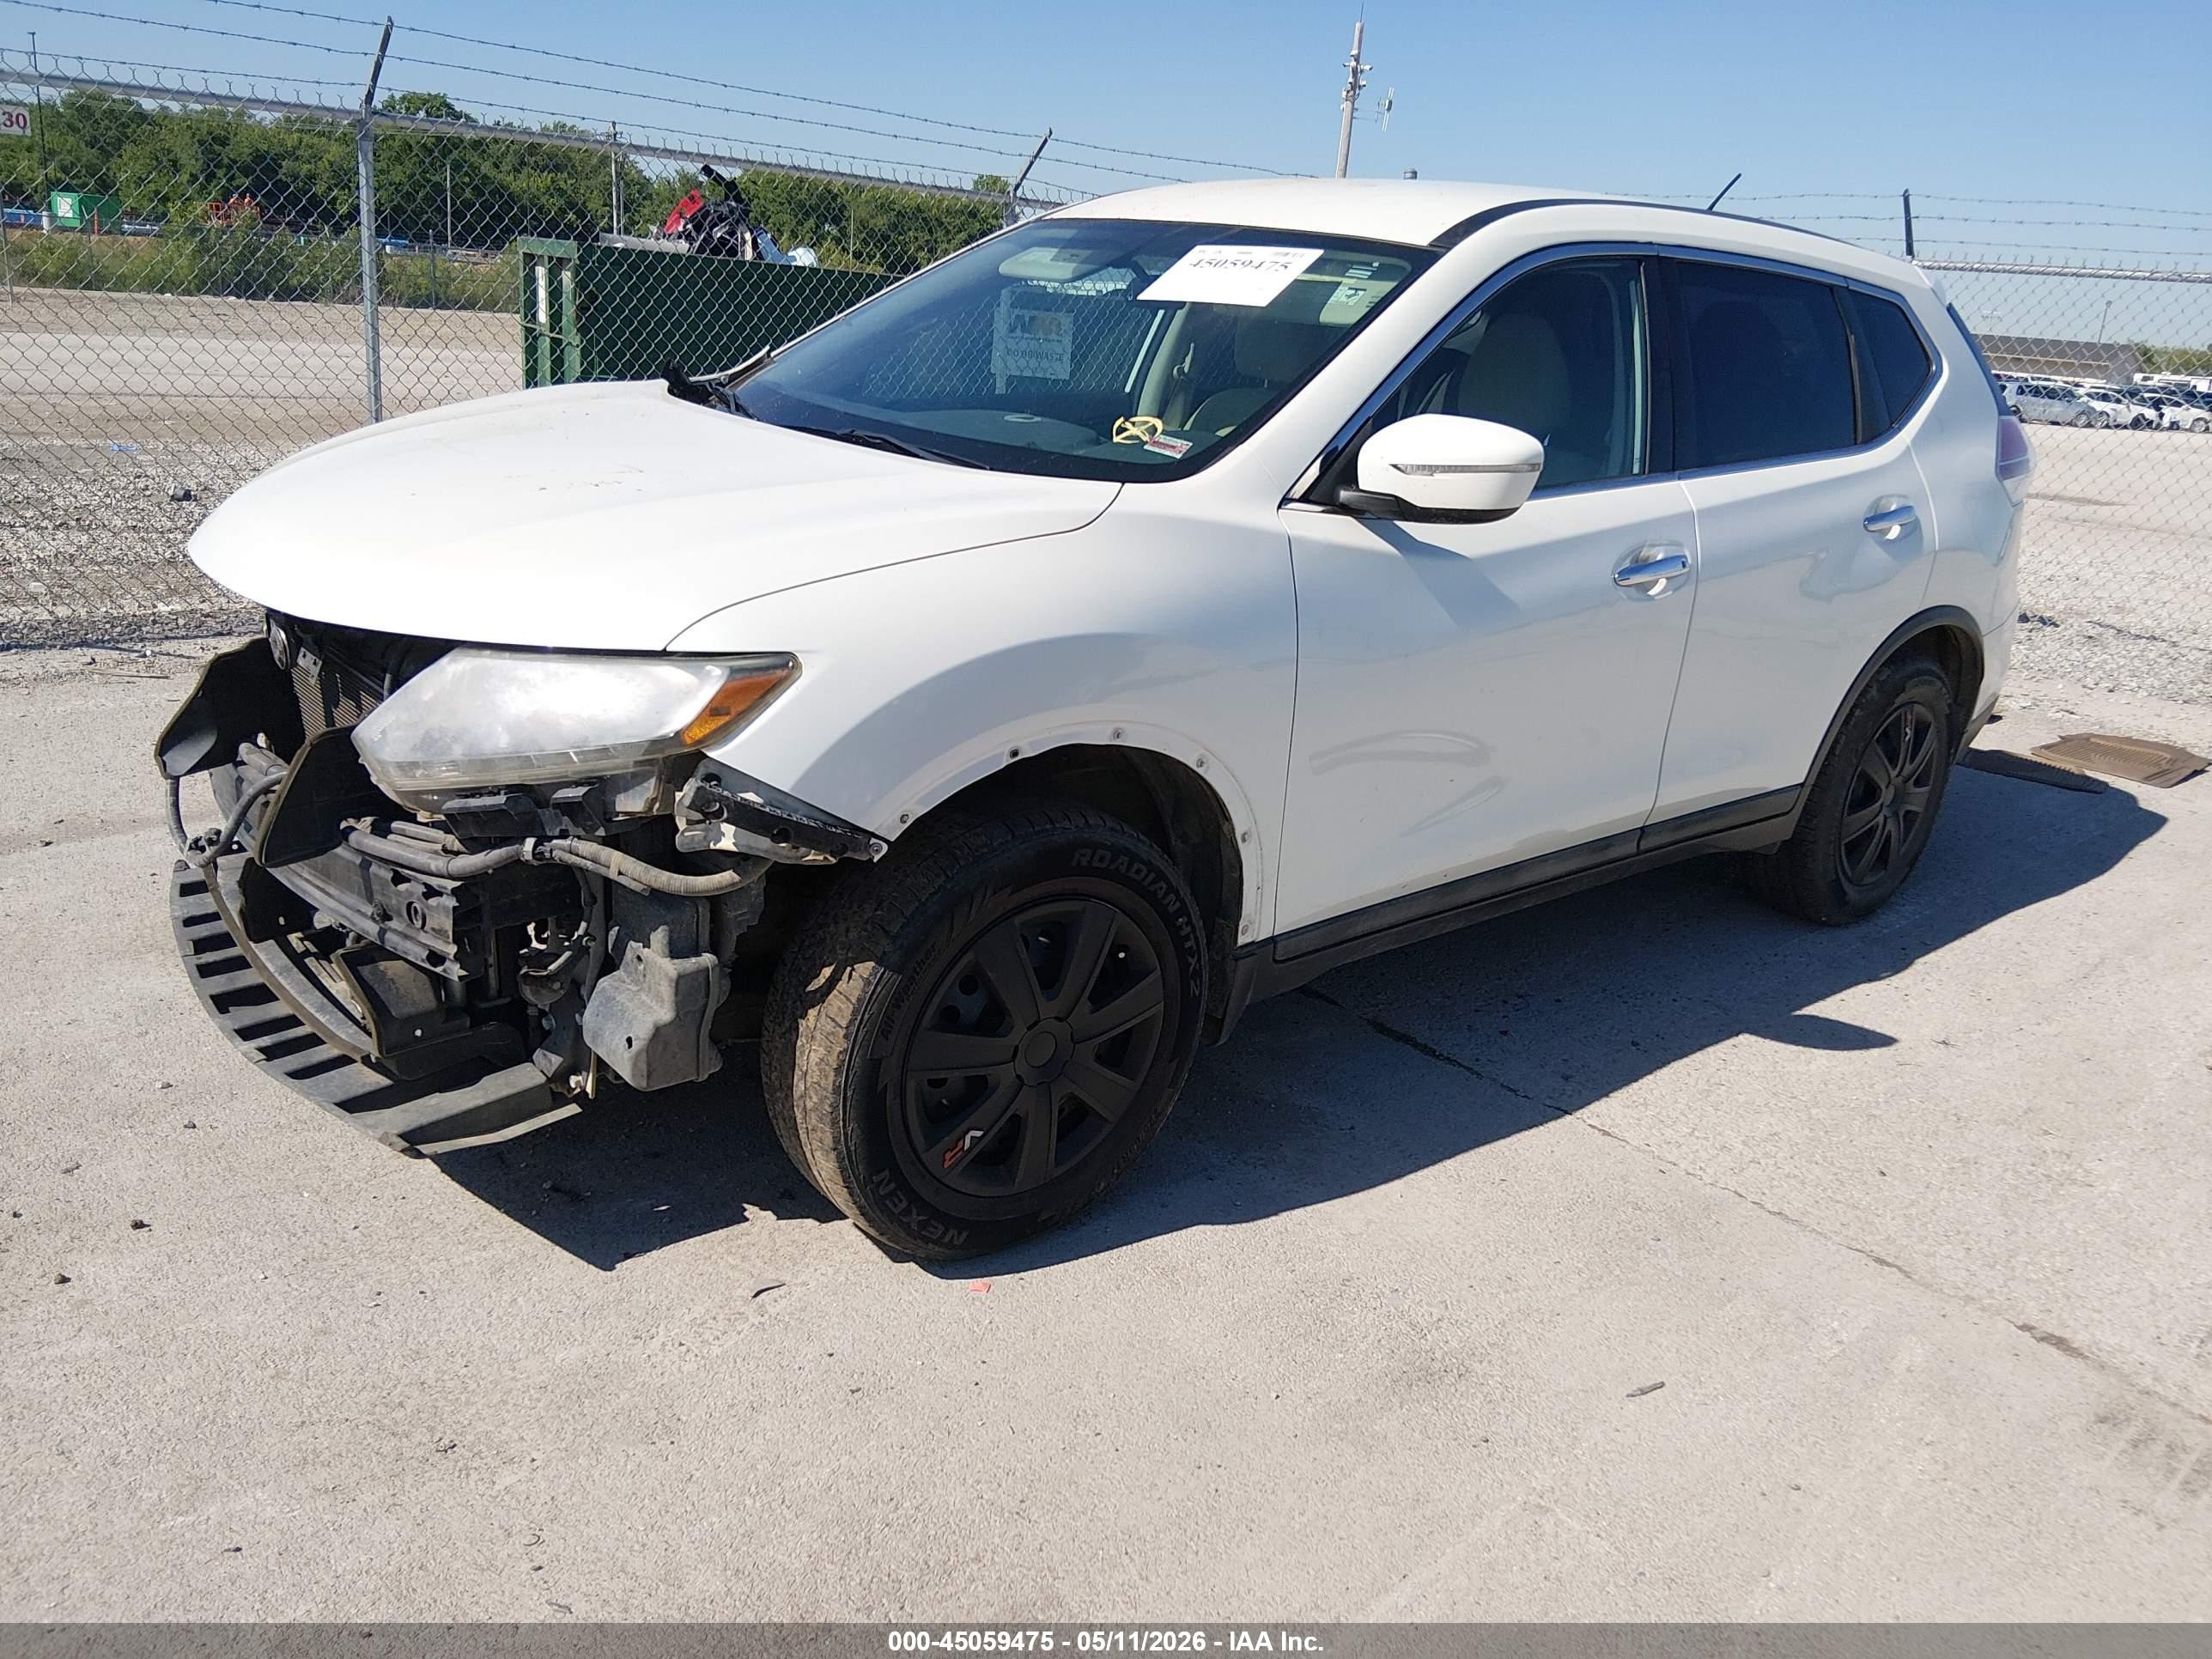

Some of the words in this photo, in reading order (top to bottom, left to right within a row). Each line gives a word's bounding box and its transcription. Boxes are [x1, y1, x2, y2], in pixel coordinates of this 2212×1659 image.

[2, 111, 27, 130] 30
[1189, 258, 1293, 272] 45059475
[1071, 848, 1182, 914] ROADIAN
[872, 1168, 970, 1246] NEXEN
